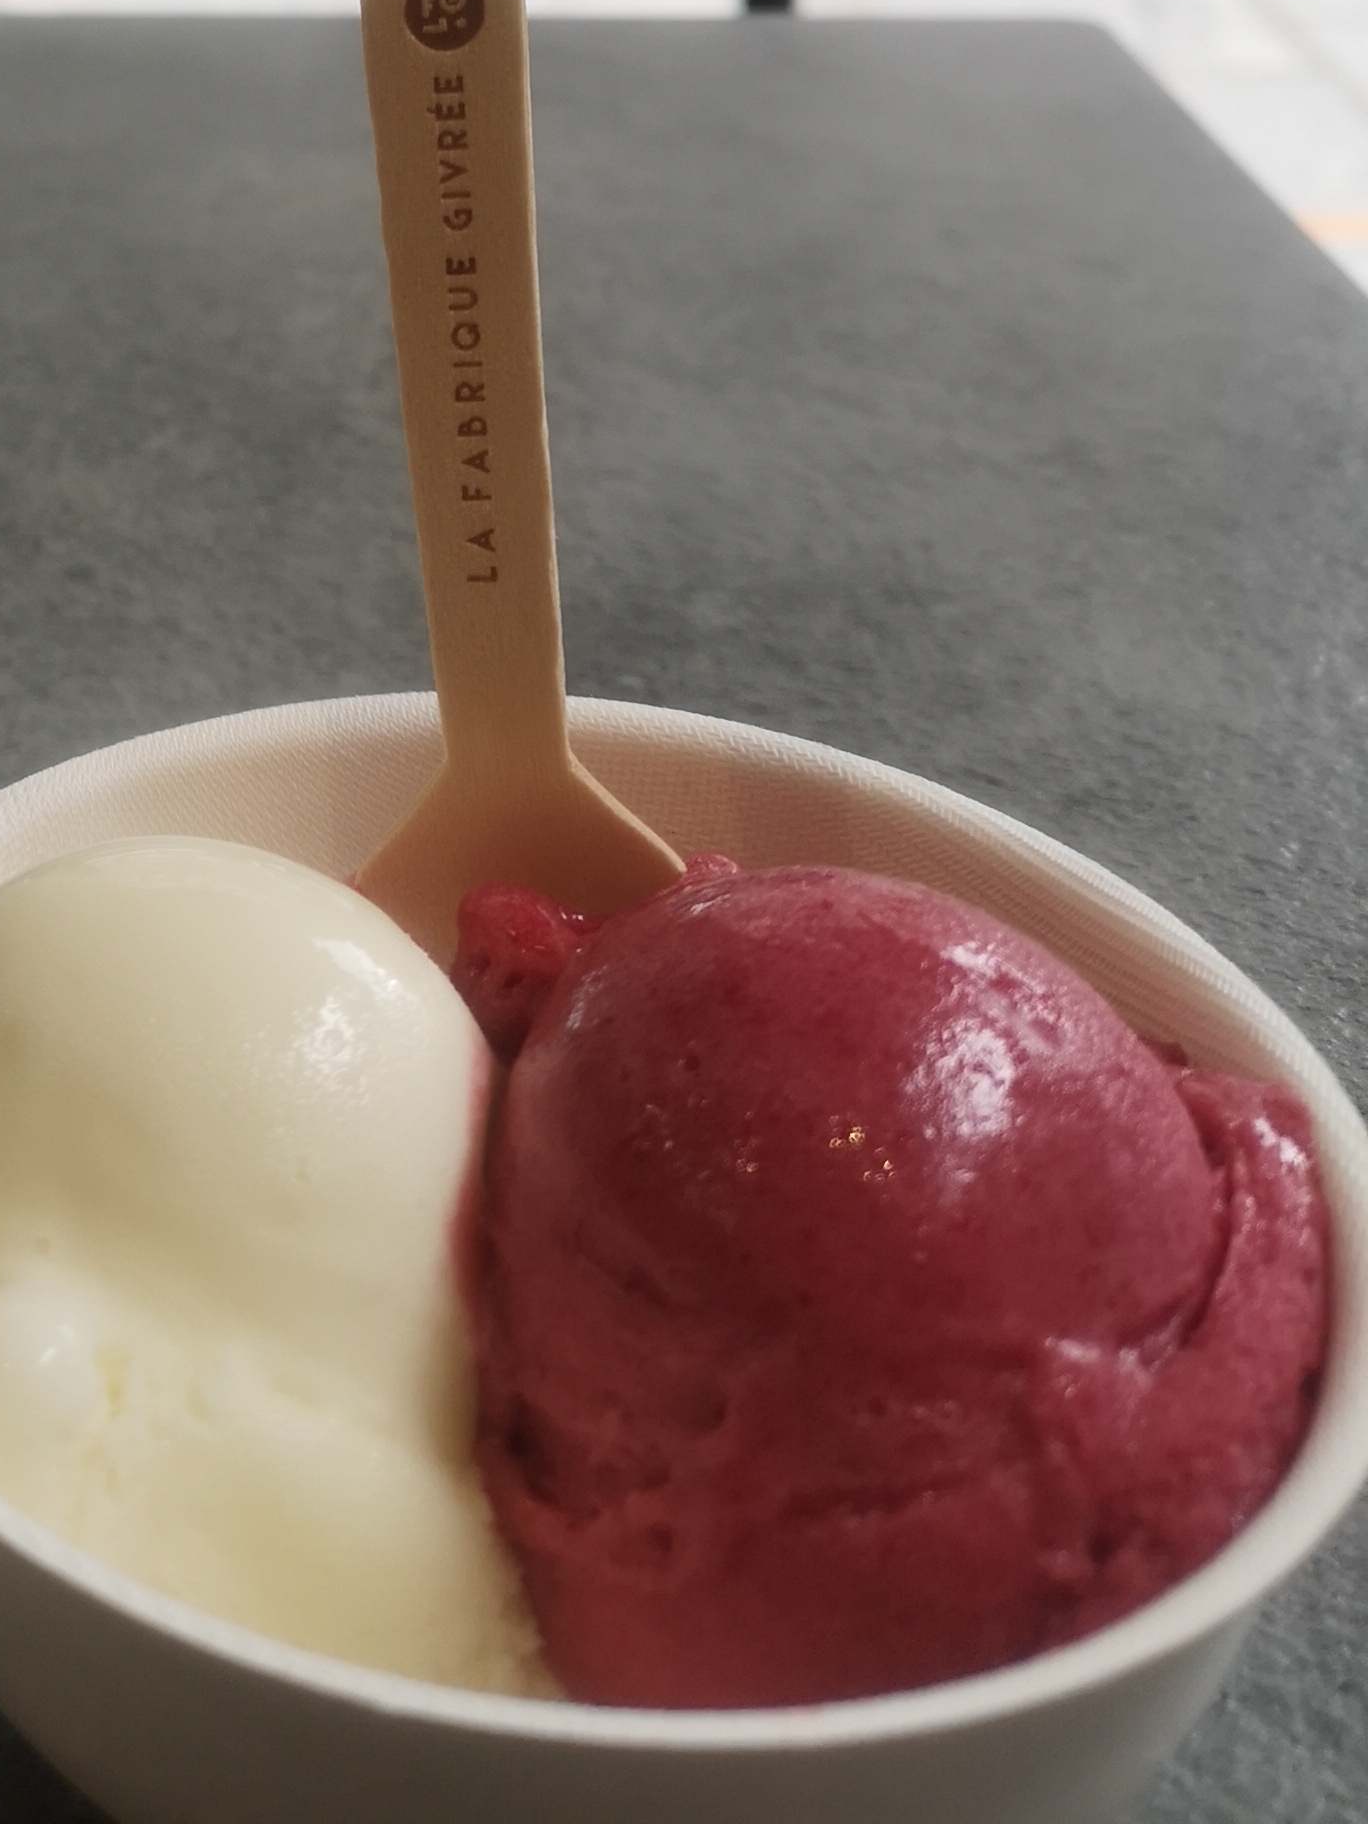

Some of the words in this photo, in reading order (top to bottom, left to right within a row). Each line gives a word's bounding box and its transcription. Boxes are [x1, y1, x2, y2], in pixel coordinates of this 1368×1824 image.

[426, 74, 473, 231] GIVRÉE
[445, 256, 493, 502] FABRIQUE
[466, 528, 499, 583] LA
